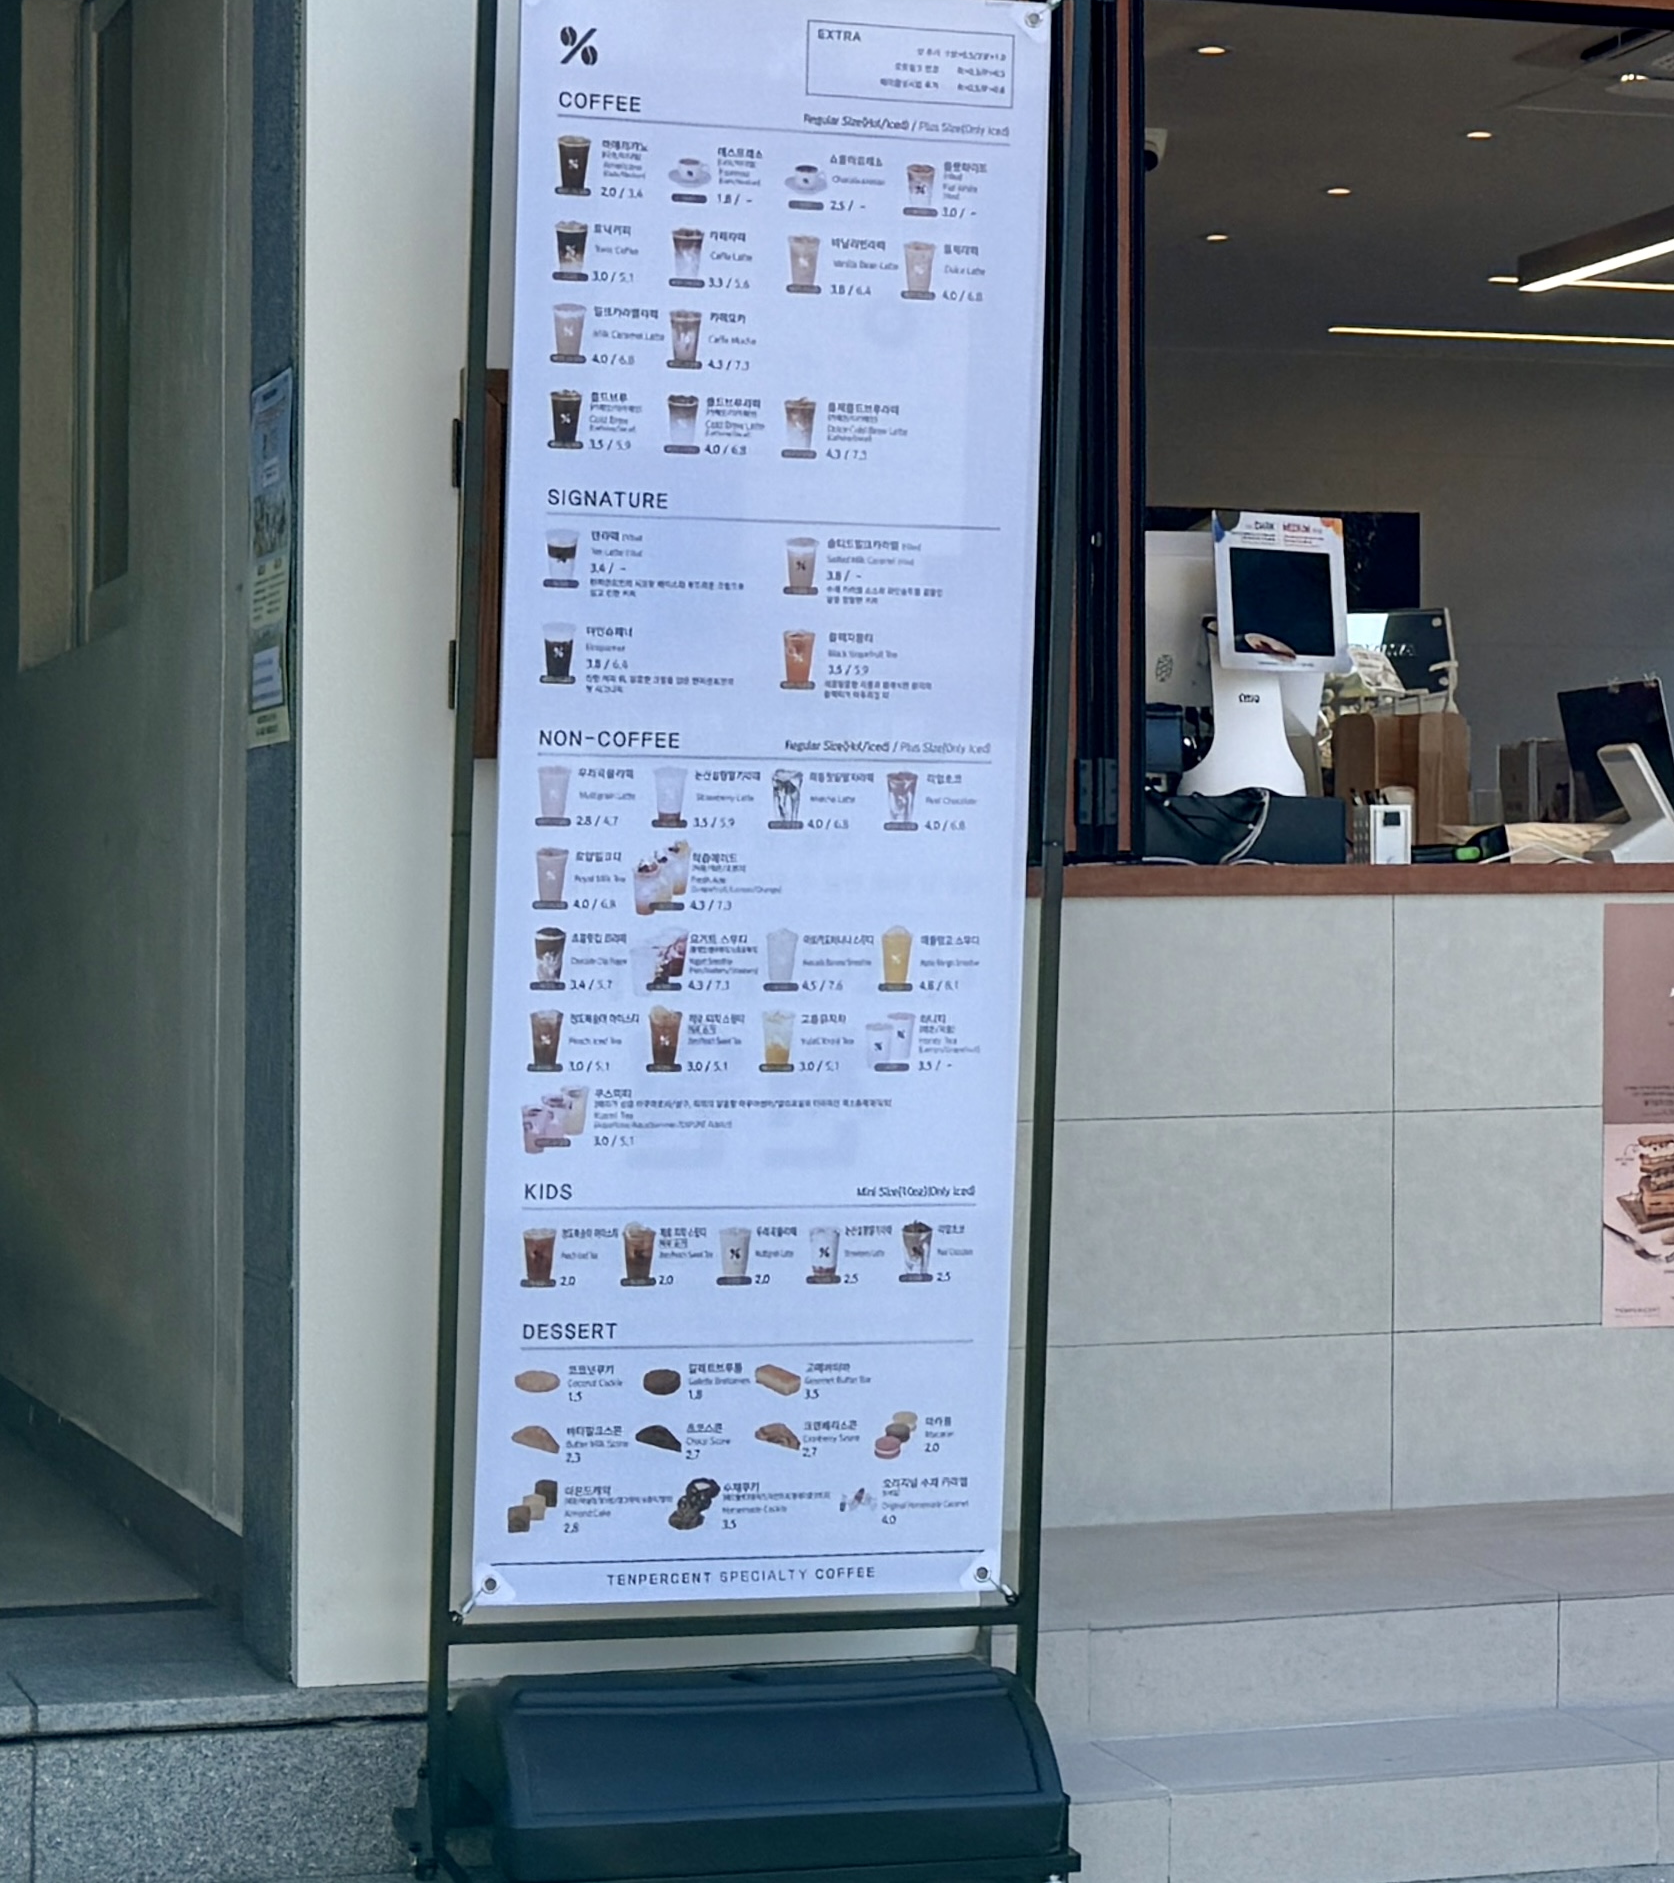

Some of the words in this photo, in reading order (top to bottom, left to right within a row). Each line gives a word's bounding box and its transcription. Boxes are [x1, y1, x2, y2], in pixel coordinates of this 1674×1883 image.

[817, 29, 861, 42] EXTRA
[558, 91, 642, 113] COFFEE
[803, 114, 839, 127] Regular
[591, 271, 608, 282] 3.0
[547, 489, 669, 510] SIGNATURE
[539, 730, 680, 749] NON-COFFEE
[785, 740, 821, 752] Regular
[524, 1183, 573, 1200] KIDS
[560, 1276, 576, 1286] 2.0
[659, 1275, 674, 1285] 2.0
[755, 1274, 770, 1285] 2.0
[844, 1274, 859, 1284] 2.5
[522, 1322, 618, 1340] DESSERT
[568, 1391, 583, 1402] 1.5
[566, 1453, 581, 1463] 2.3
[606, 1572, 712, 1586] TENPERCENT
[719, 1569, 808, 1583] SPECIALTY
[815, 1566, 876, 1580] COFFEE
